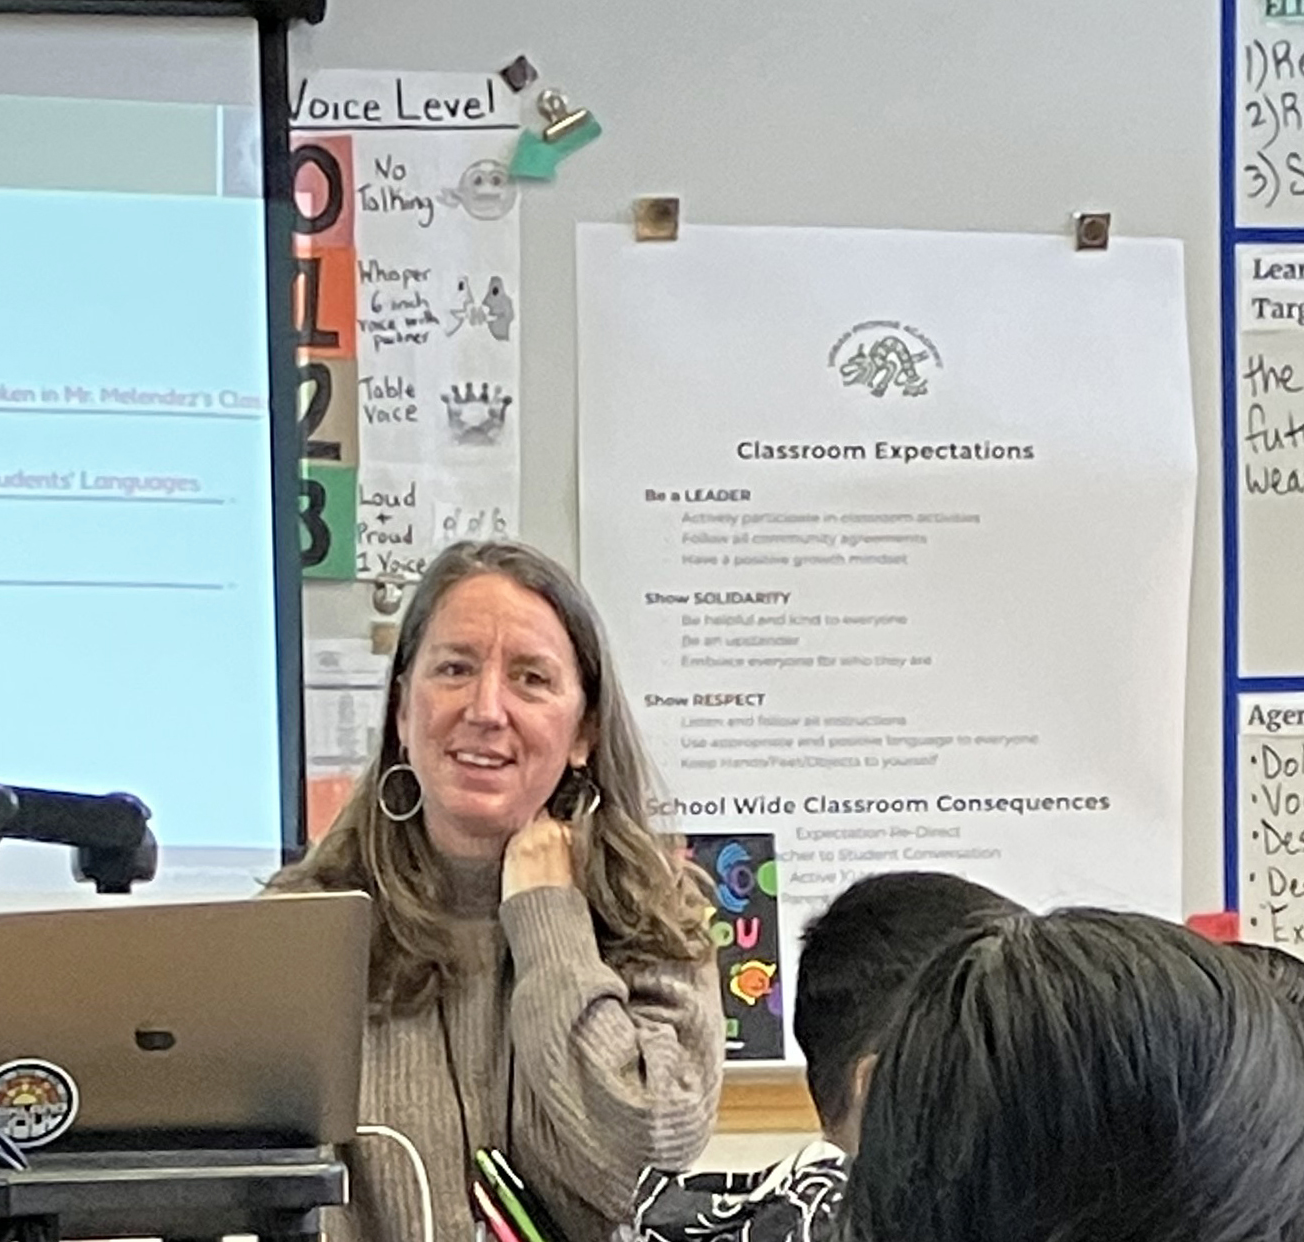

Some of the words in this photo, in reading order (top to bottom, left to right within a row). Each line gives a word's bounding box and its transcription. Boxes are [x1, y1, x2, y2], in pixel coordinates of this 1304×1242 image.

[290, 78, 382, 122] Voice
[396, 77, 495, 122] Level
[374, 154, 407, 181] No
[291, 143, 344, 235] 0
[357, 182, 435, 229] Talking
[370, 289, 383, 314] 6
[390, 290, 430, 312] inch
[1243, 353, 1304, 397] the
[40, 385, 60, 403] in
[358, 375, 417, 401] Table
[298, 362, 342, 461] 2
[363, 404, 419, 425] Voice
[736, 441, 868, 461] Classroom
[874, 440, 1036, 465] Expectations
[80, 470, 203, 496] Languages
[358, 480, 417, 508] Loud
[644, 488, 666, 502] Be
[684, 488, 752, 502] LEADER
[299, 479, 332, 568] 3
[358, 522, 414, 545] Proud
[376, 550, 427, 575] Voice
[644, 592, 690, 605] Show
[693, 591, 792, 605] SOLIDARITY
[644, 692, 689, 707] Show
[692, 692, 767, 707] RESPECT
[645, 797, 726, 816] School
[733, 795, 796, 815] Wide
[803, 794, 929, 815] Classroom
[935, 792, 1112, 816] Consequences
